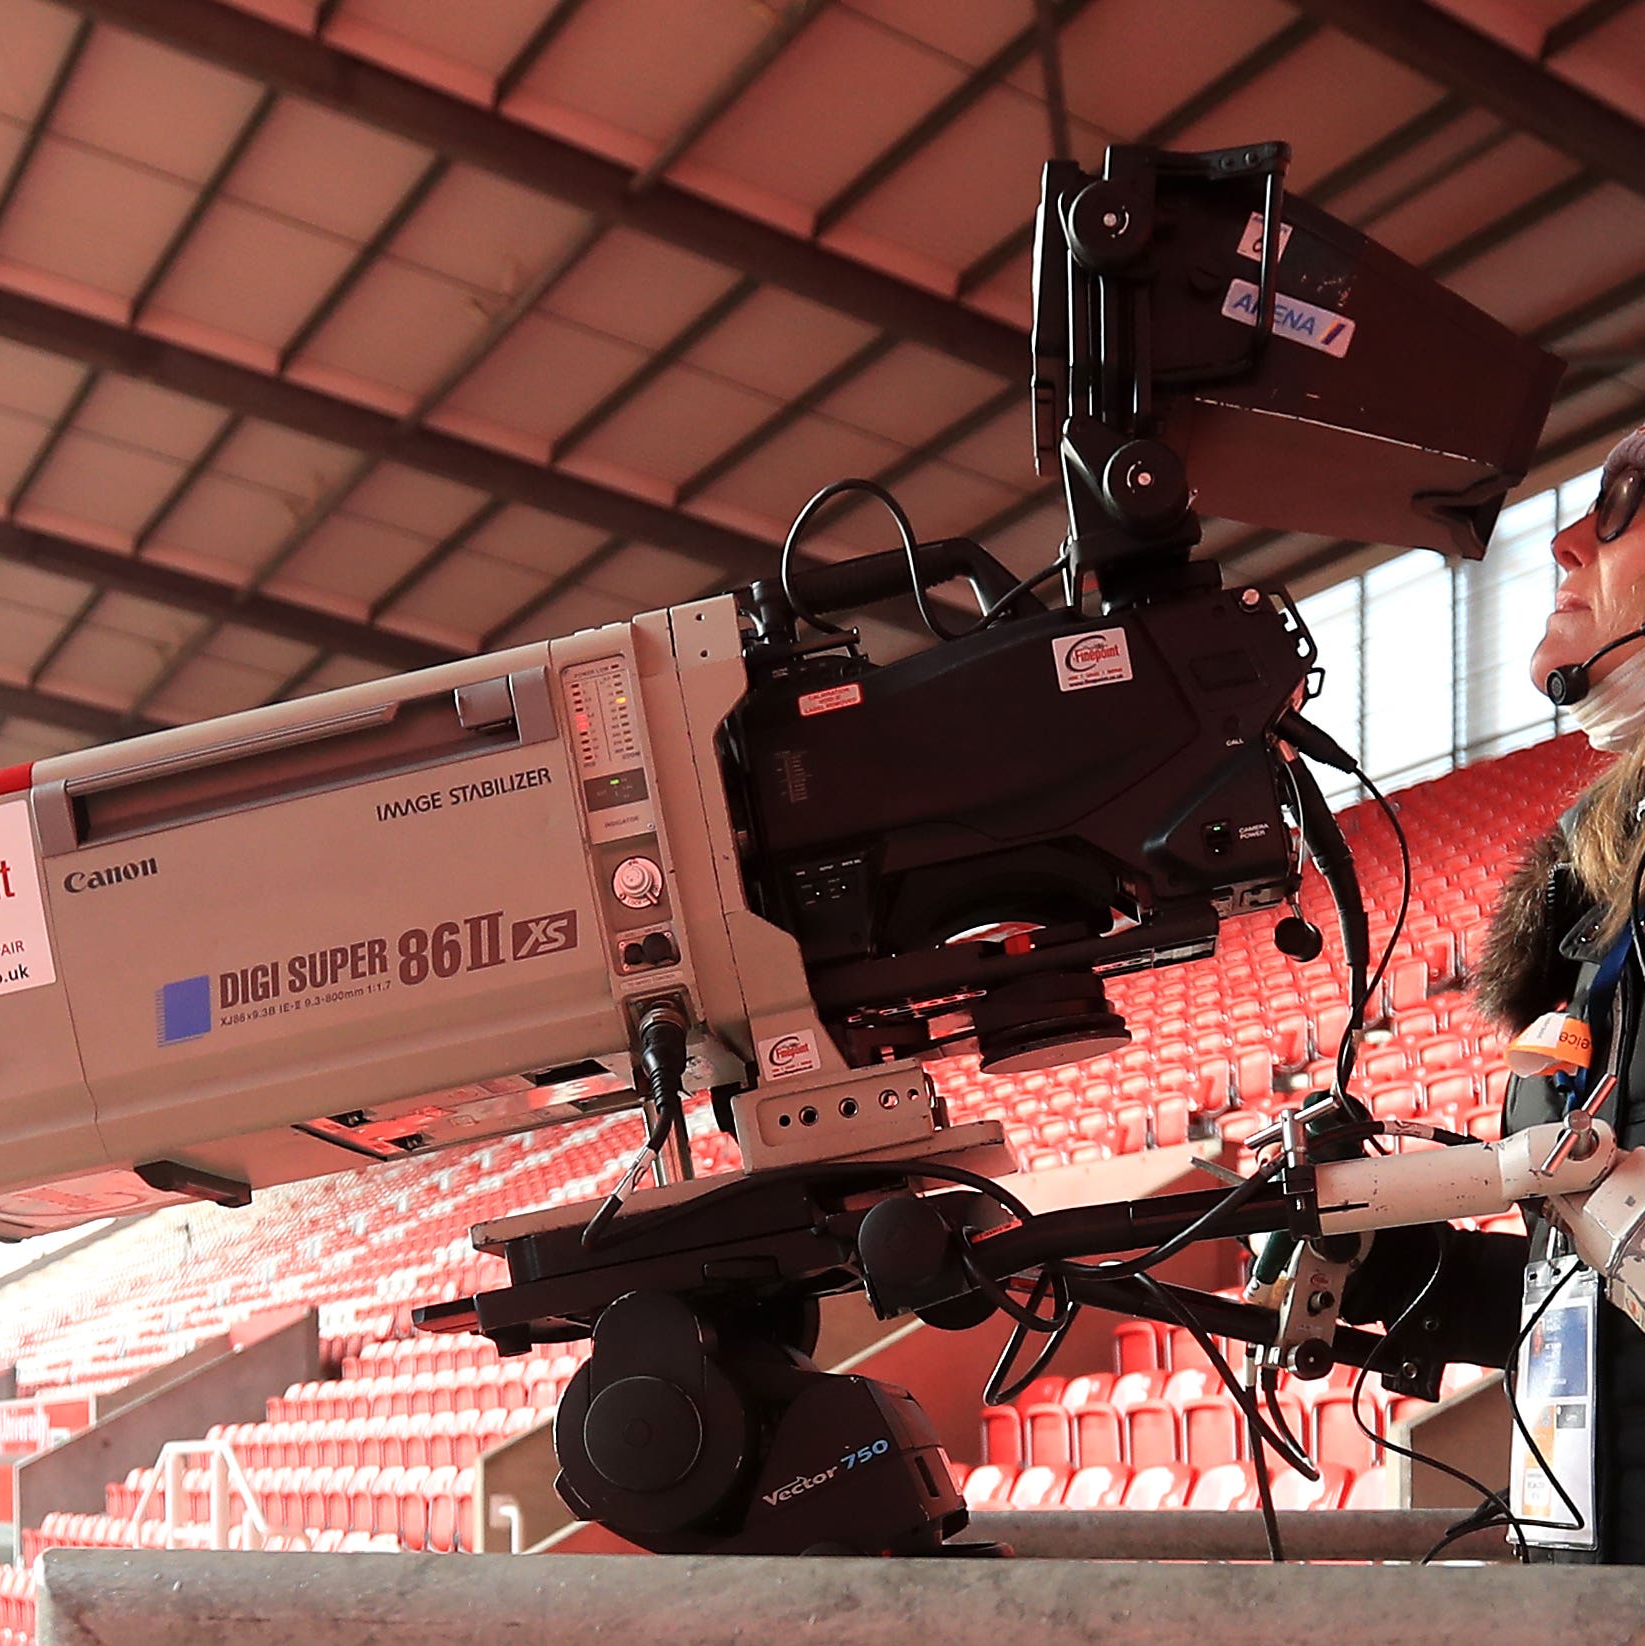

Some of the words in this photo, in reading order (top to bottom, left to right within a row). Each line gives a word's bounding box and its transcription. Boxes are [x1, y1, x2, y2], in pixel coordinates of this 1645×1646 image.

[1074, 644, 1120, 663] Finepoint
[1225, 738, 1245, 747] CALL
[376, 790, 443, 822] IMAGE
[449, 766, 553, 807] STABILIZER
[1238, 822, 1270, 834] CAMERA
[1239, 830, 1267, 840] POWER
[63, 856, 158, 894] Canon
[219, 961, 280, 1009] DIGI
[287, 938, 388, 993] SUPER
[366, 980, 392, 994] 1:1.7
[762, 1465, 839, 1507] Vector
[840, 1439, 889, 1470] 750
